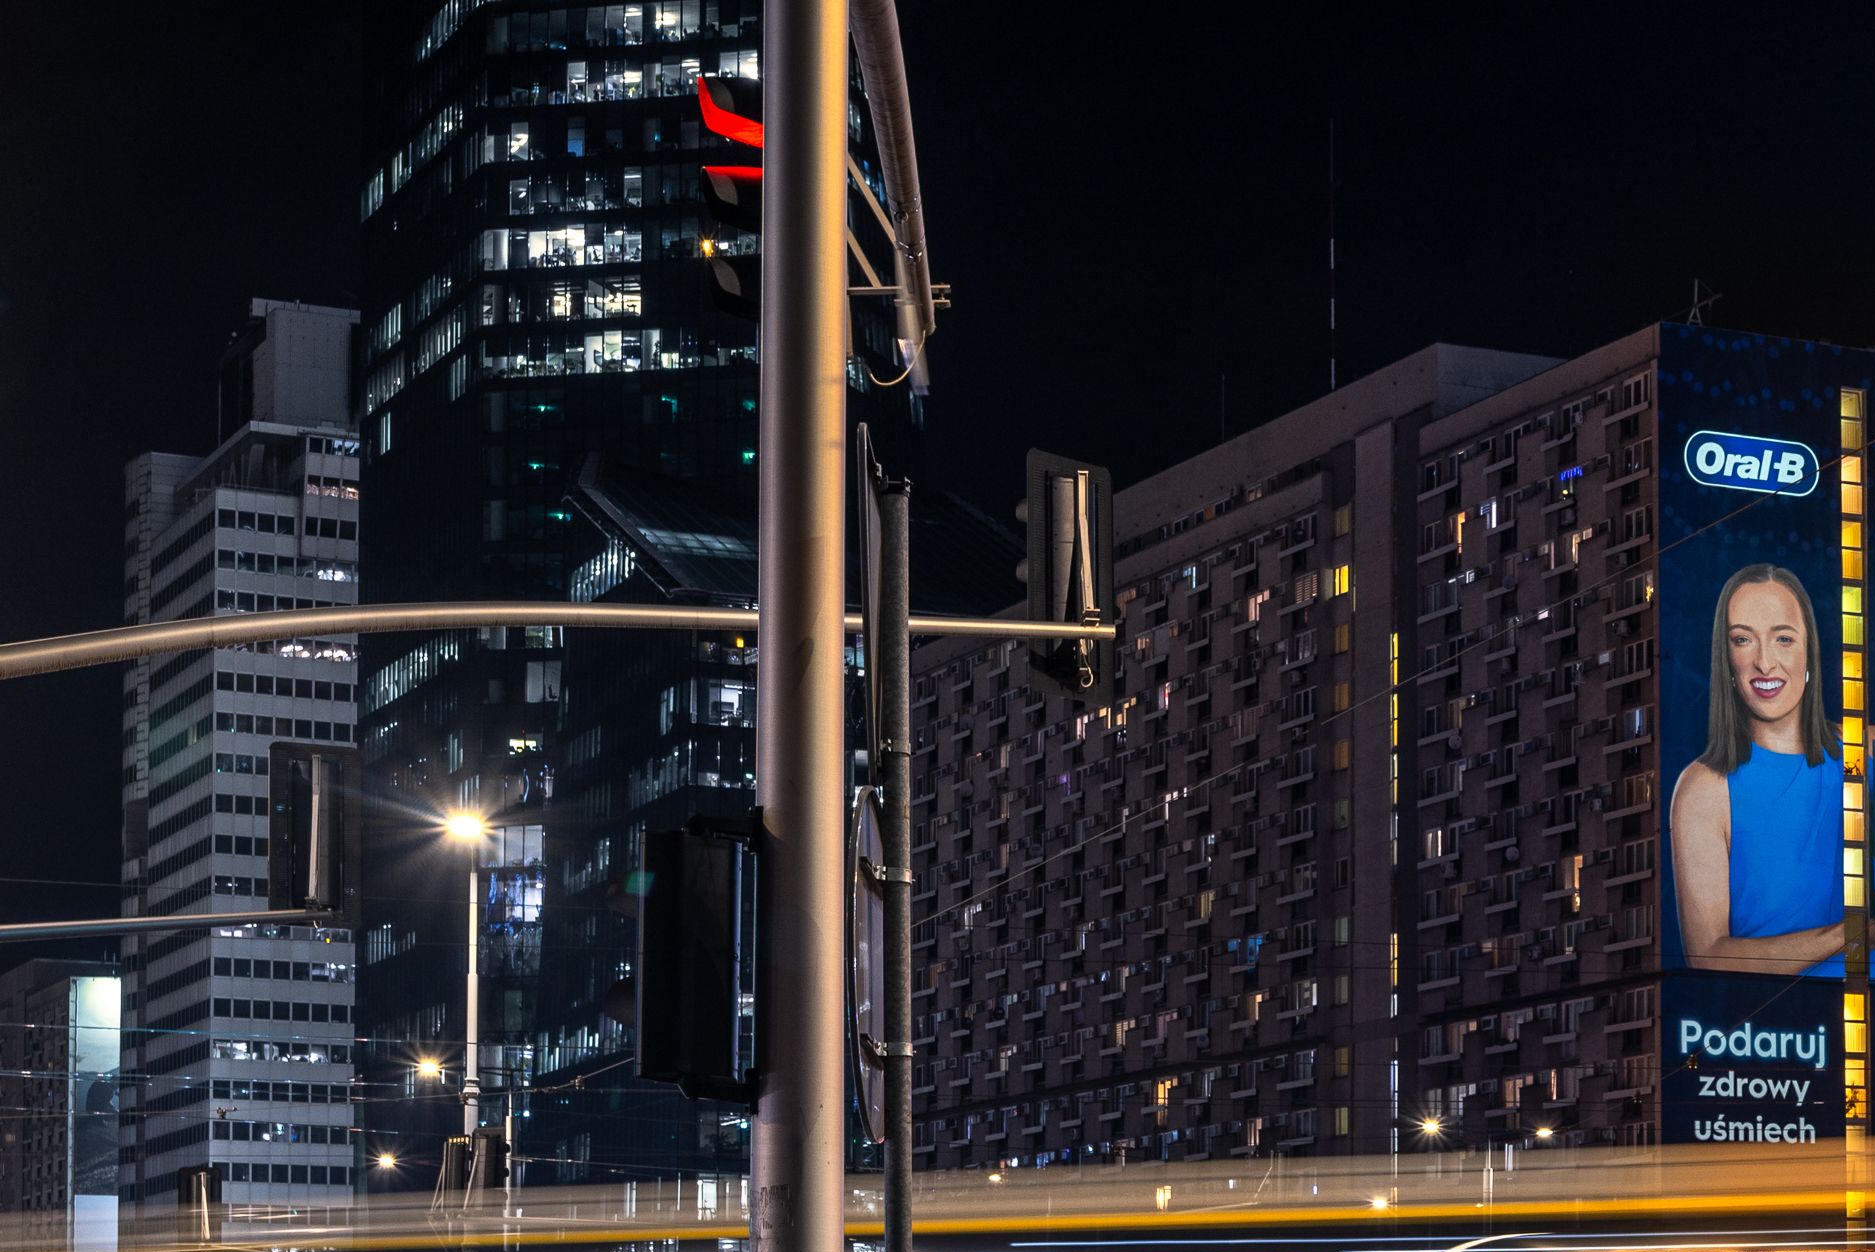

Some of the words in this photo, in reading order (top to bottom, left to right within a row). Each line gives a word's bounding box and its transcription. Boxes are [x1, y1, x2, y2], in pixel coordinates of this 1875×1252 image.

[1696, 441, 1805, 485] Oral-B
[1680, 1019, 1826, 1069] Podaruj
[1698, 1071, 1811, 1107] zdrowy
[1694, 1113, 1816, 1144] uśmiech
